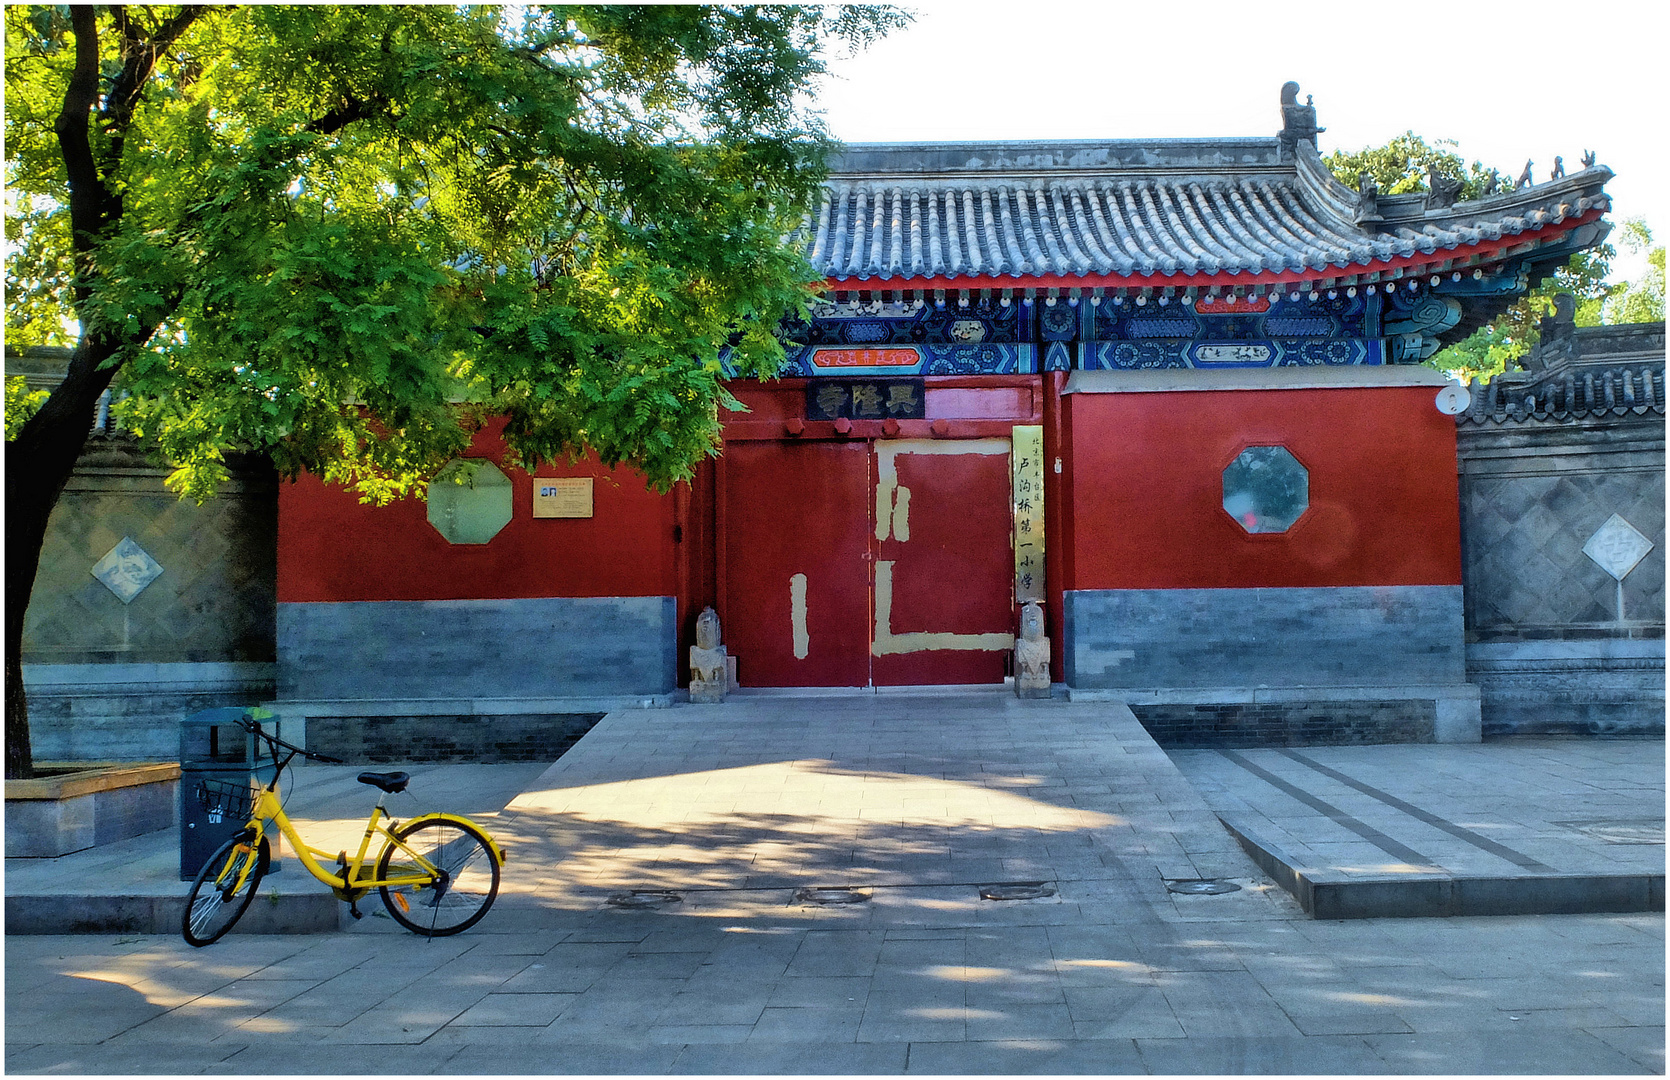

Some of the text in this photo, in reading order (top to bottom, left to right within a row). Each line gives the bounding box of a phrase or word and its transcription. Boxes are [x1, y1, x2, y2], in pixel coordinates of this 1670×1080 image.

[1018, 457, 1033, 590] 卢沟桥第一小学
